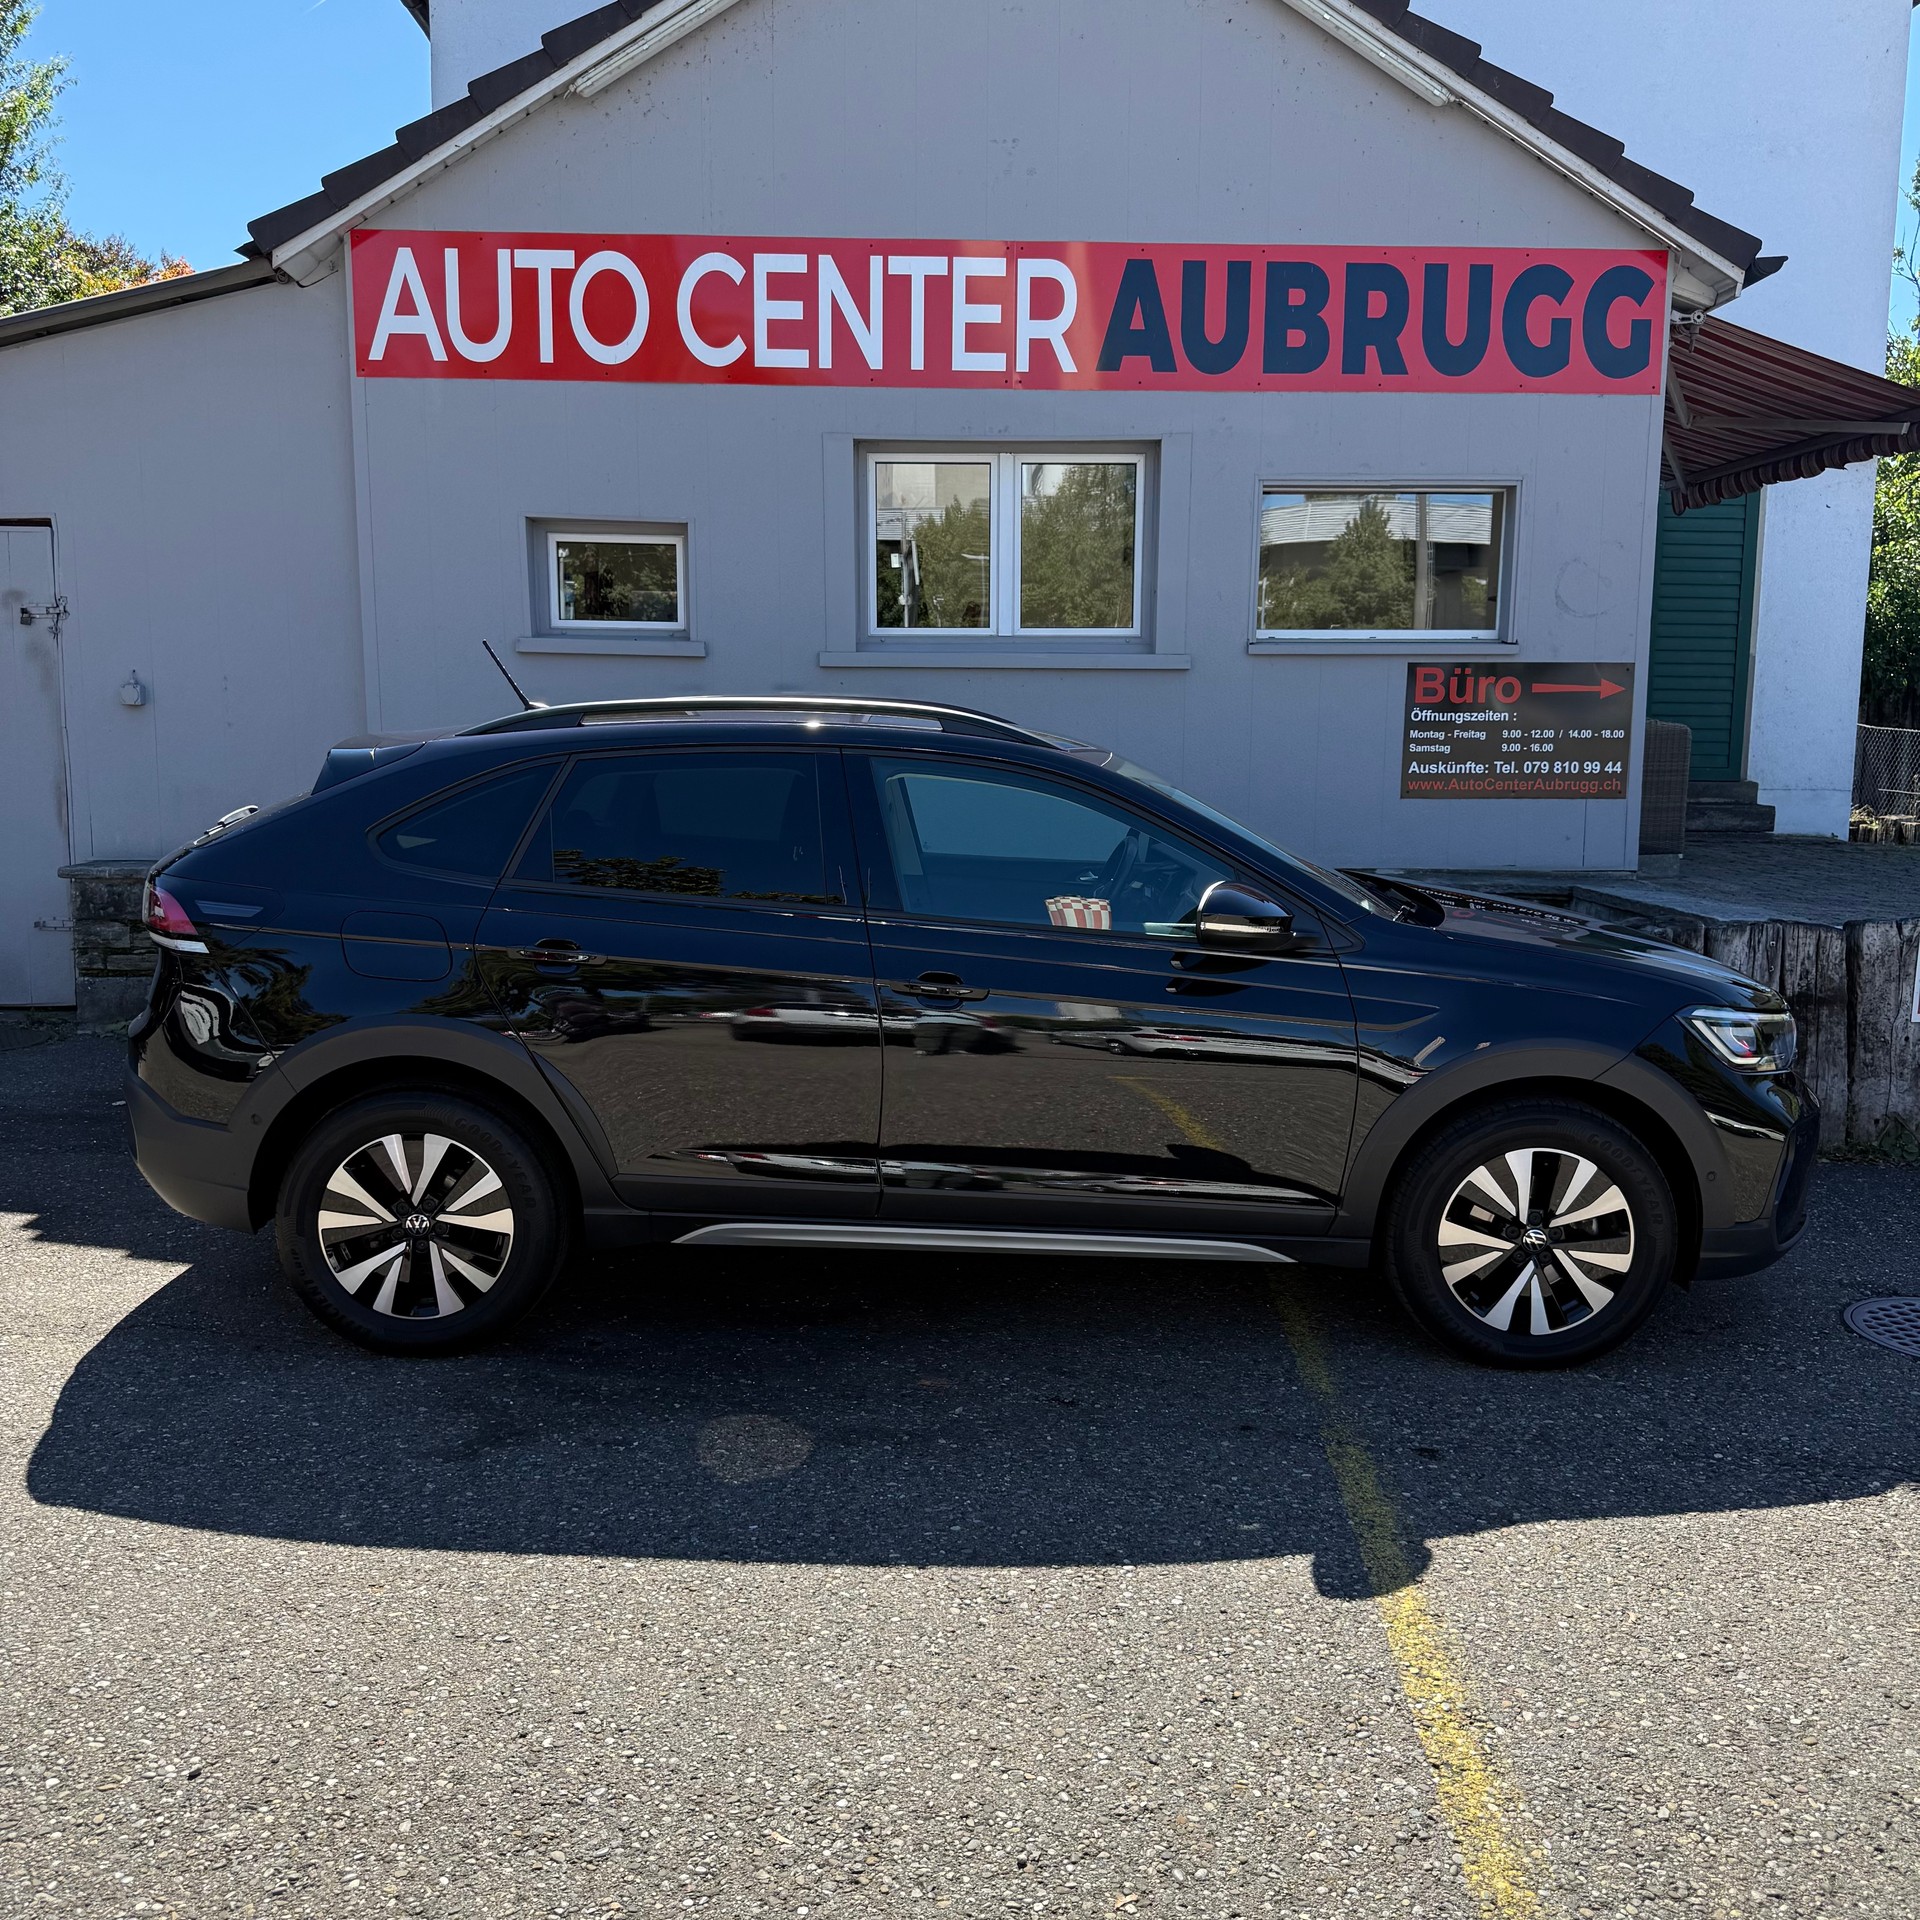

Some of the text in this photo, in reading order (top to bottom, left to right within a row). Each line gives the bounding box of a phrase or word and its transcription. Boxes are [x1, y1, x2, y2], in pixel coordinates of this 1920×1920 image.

[367, 246, 1655, 379] AUTO CENTER AUBRUGG
[1414, 667, 1522, 704] Büro
[1410, 707, 1509, 724] Öffnungszeiten
[1409, 730, 1445, 740] Montag
[1453, 730, 1486, 740] Freitag
[1502, 730, 1522, 739] 9.00
[1531, 730, 1555, 739] 12.00
[1568, 730, 1592, 739] 14.00
[1601, 730, 1624, 739] 18.00
[1409, 743, 1451, 754] Samstag
[1501, 743, 1521, 752] 9.00
[1530, 743, 1554, 752] 16.00
[1408, 761, 1622, 774] Auskünfte: Tel. 079 810 99 44
[1407, 778, 1622, 793] www.AutoCenterAubrugg.ch
